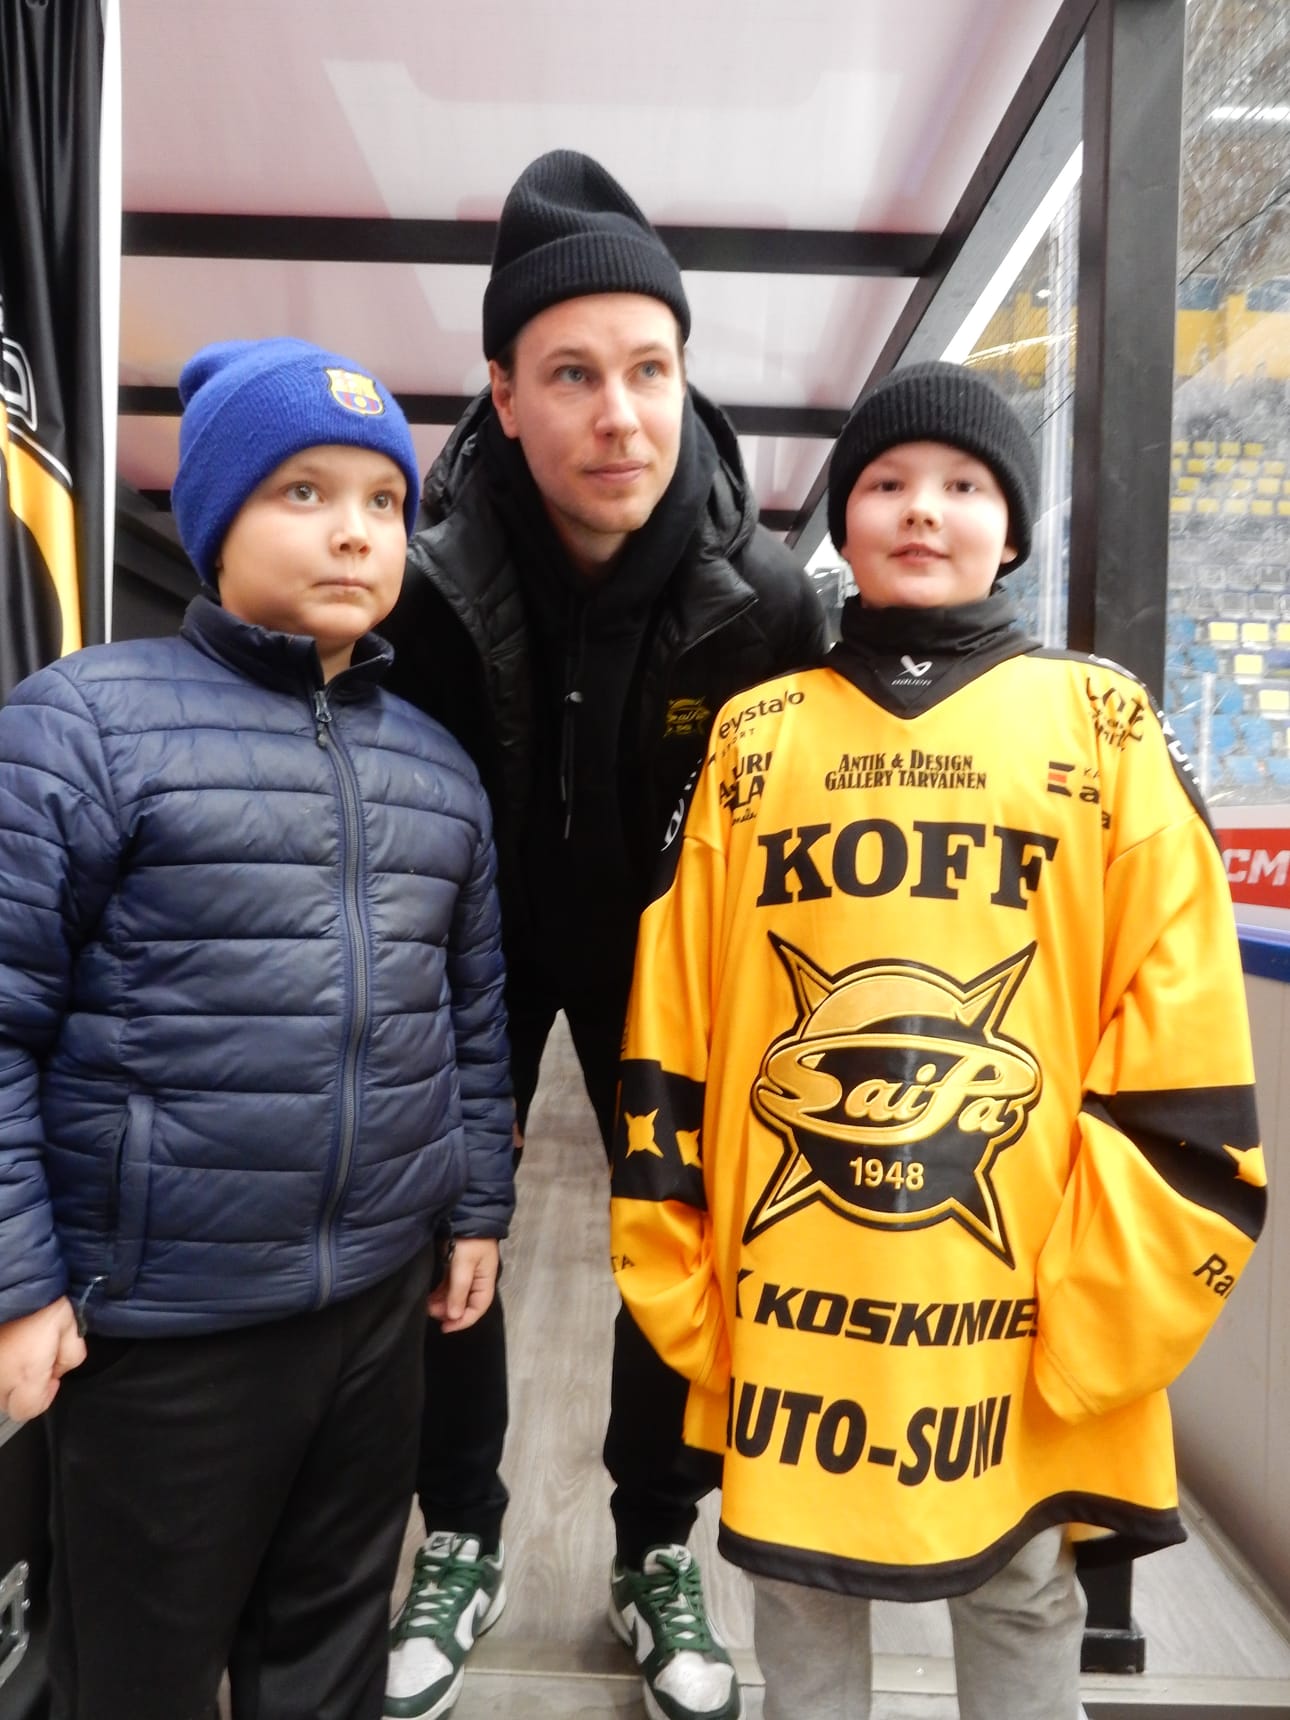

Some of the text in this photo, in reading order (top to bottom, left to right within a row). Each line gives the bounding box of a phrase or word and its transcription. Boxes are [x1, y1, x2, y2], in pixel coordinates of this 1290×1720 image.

[824, 769, 988, 792] GALLERY TARVAINEN
[838, 748, 973, 773] ANTIK & DESIGN
[756, 818, 1060, 911] KOFF
[752, 1033, 1043, 1147] SaiPa
[850, 1156, 926, 1191] 1948
[1192, 1253, 1236, 1300] Ra
[727, 1376, 1012, 1487] UTO-SUNI
